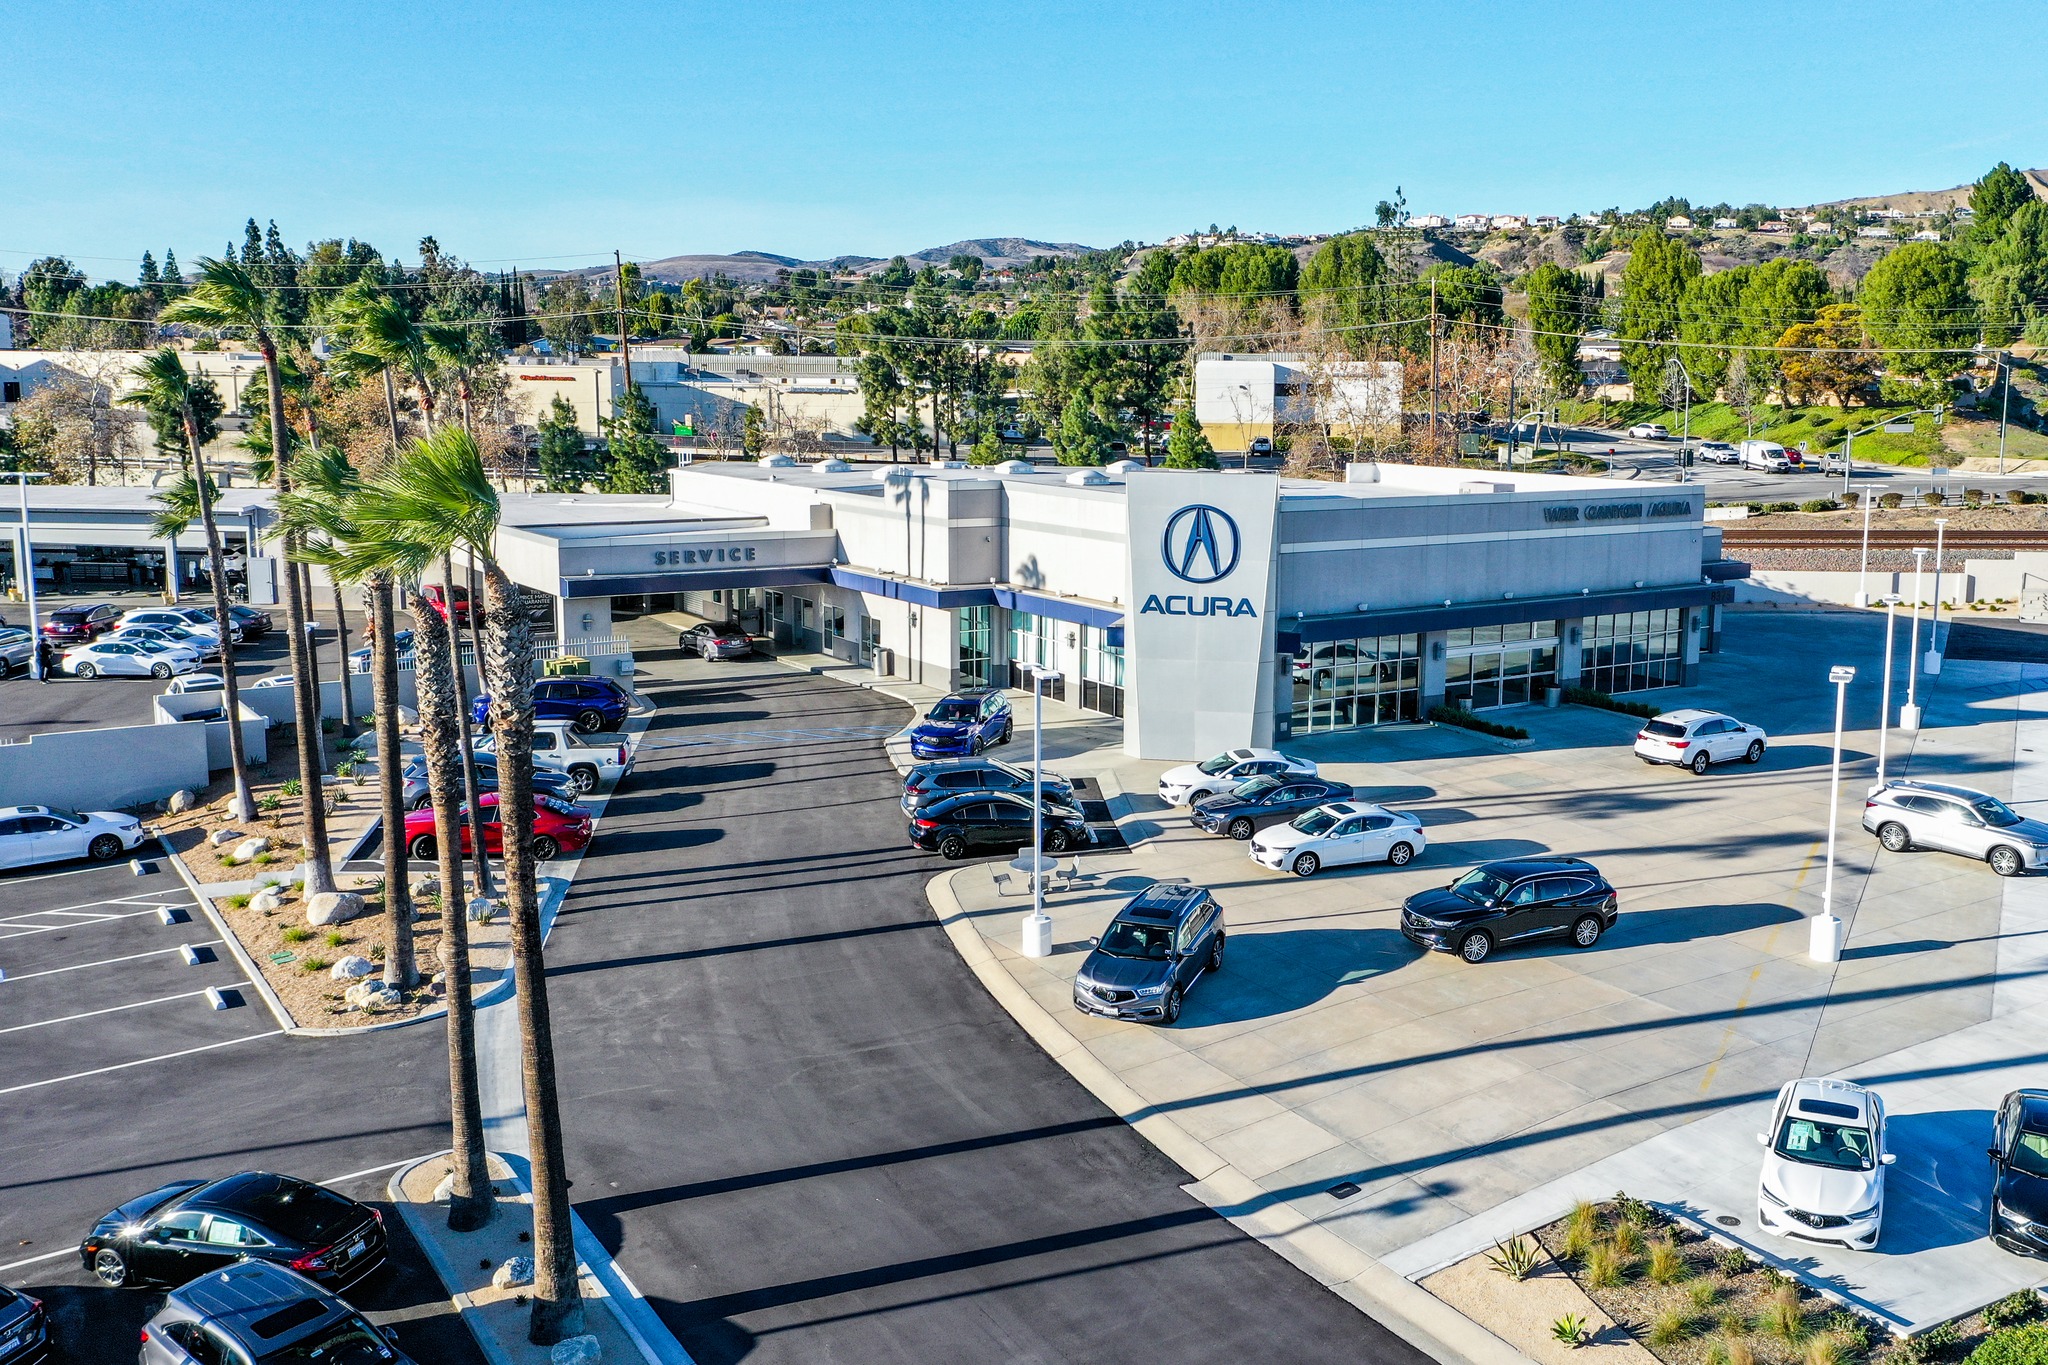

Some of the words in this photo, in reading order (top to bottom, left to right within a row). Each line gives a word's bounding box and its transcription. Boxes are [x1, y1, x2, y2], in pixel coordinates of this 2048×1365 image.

[1544, 506, 1579, 522] WEIR
[1584, 503, 1642, 520] CANYON
[1647, 501, 1691, 517] ACURA
[655, 547, 756, 566] SERVICE
[1140, 594, 1257, 617] ACURA
